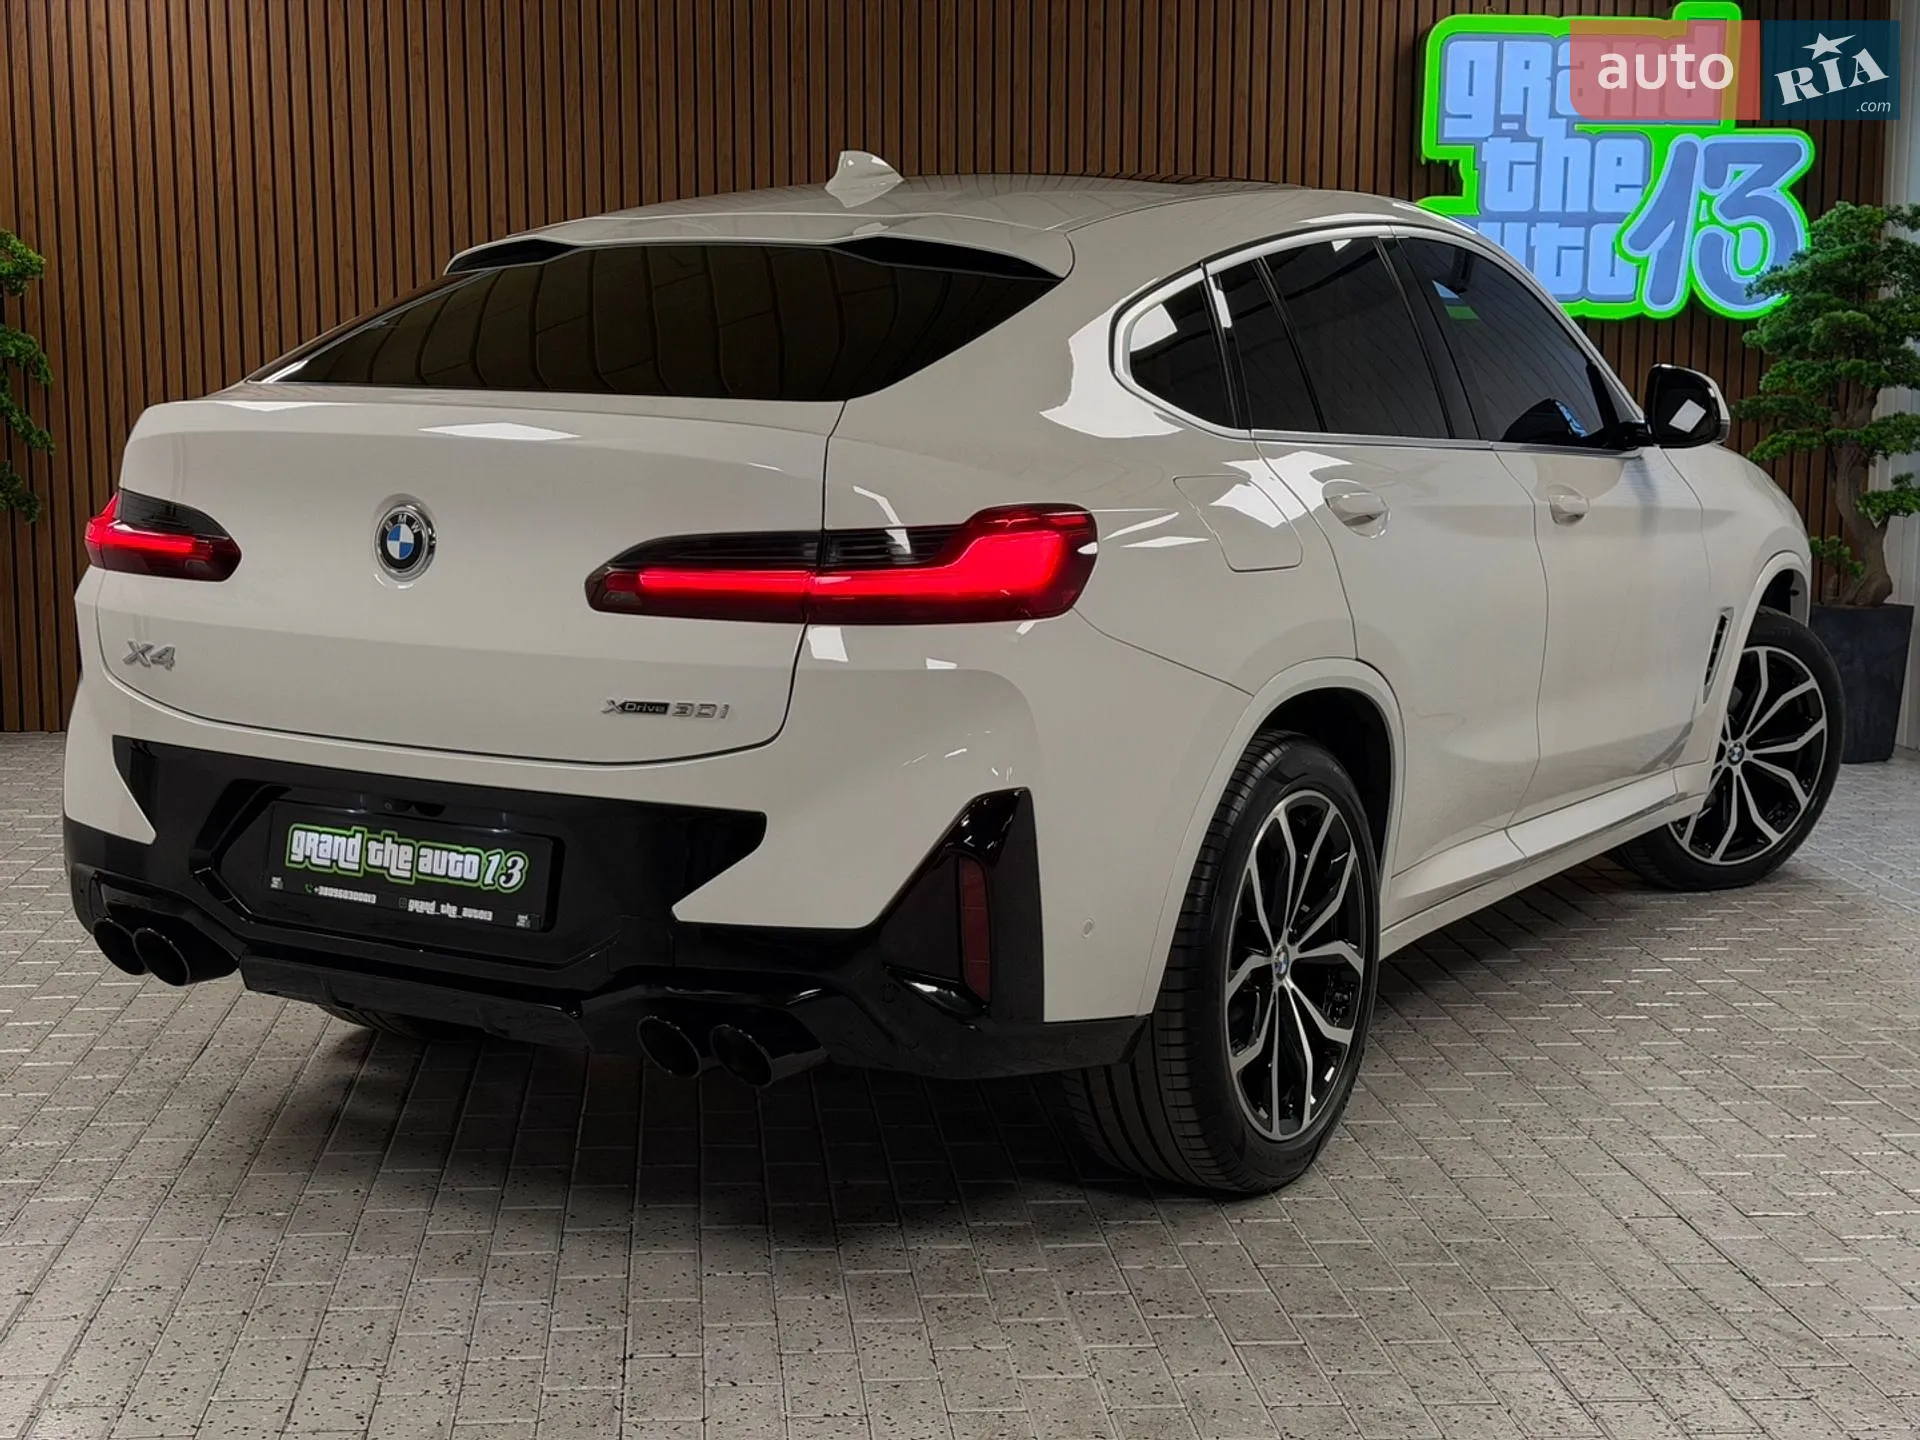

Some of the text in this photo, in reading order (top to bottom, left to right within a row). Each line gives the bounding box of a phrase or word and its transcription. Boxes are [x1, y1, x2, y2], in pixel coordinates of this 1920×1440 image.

[1481, 118, 1648, 213] the
[382, 513, 422, 534] BMW
[121, 640, 176, 671] X4
[672, 702, 730, 719] 30i
[367, 837, 414, 879] the
